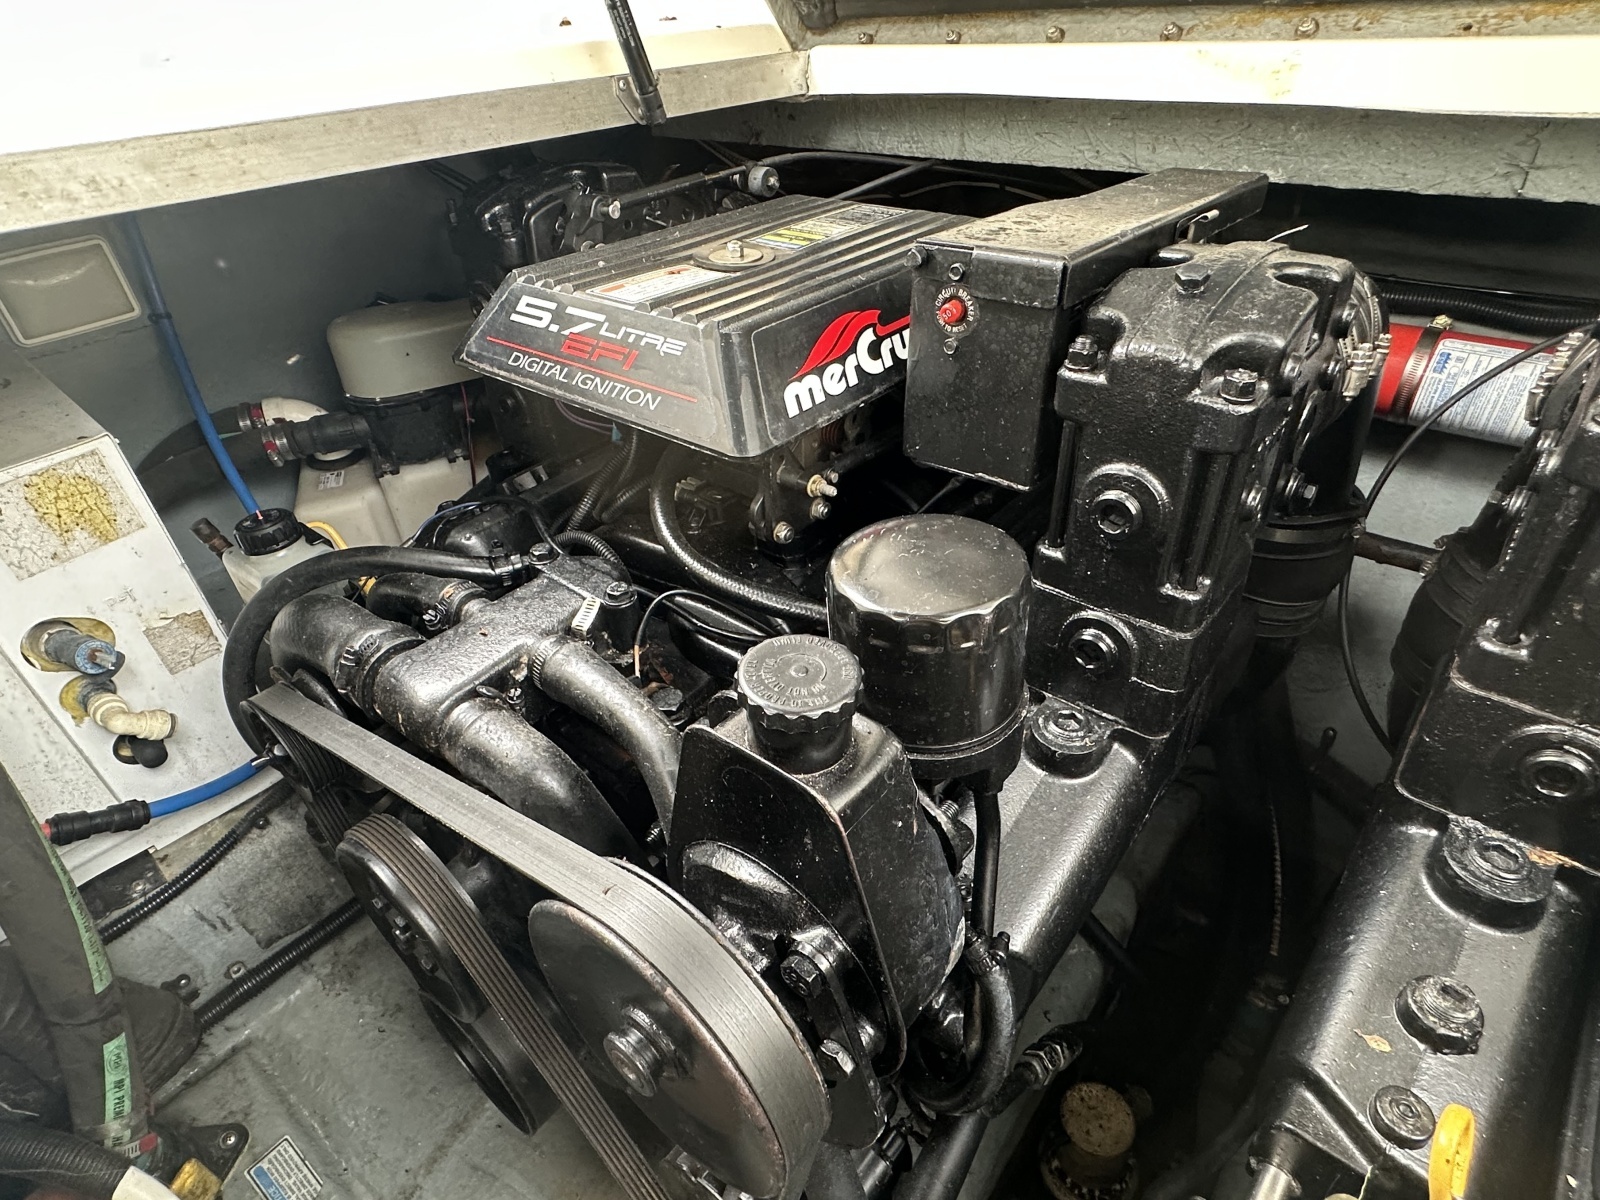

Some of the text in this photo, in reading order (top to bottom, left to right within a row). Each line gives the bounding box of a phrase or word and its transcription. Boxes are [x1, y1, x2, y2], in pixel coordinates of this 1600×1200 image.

[509, 294, 687, 356] 5.7 LITRE
[958, 288, 975, 322] BREAKER
[507, 351, 662, 411] DIGITAL IGNITION
[560, 332, 639, 371] EFI
[783, 327, 910, 418] merCru
